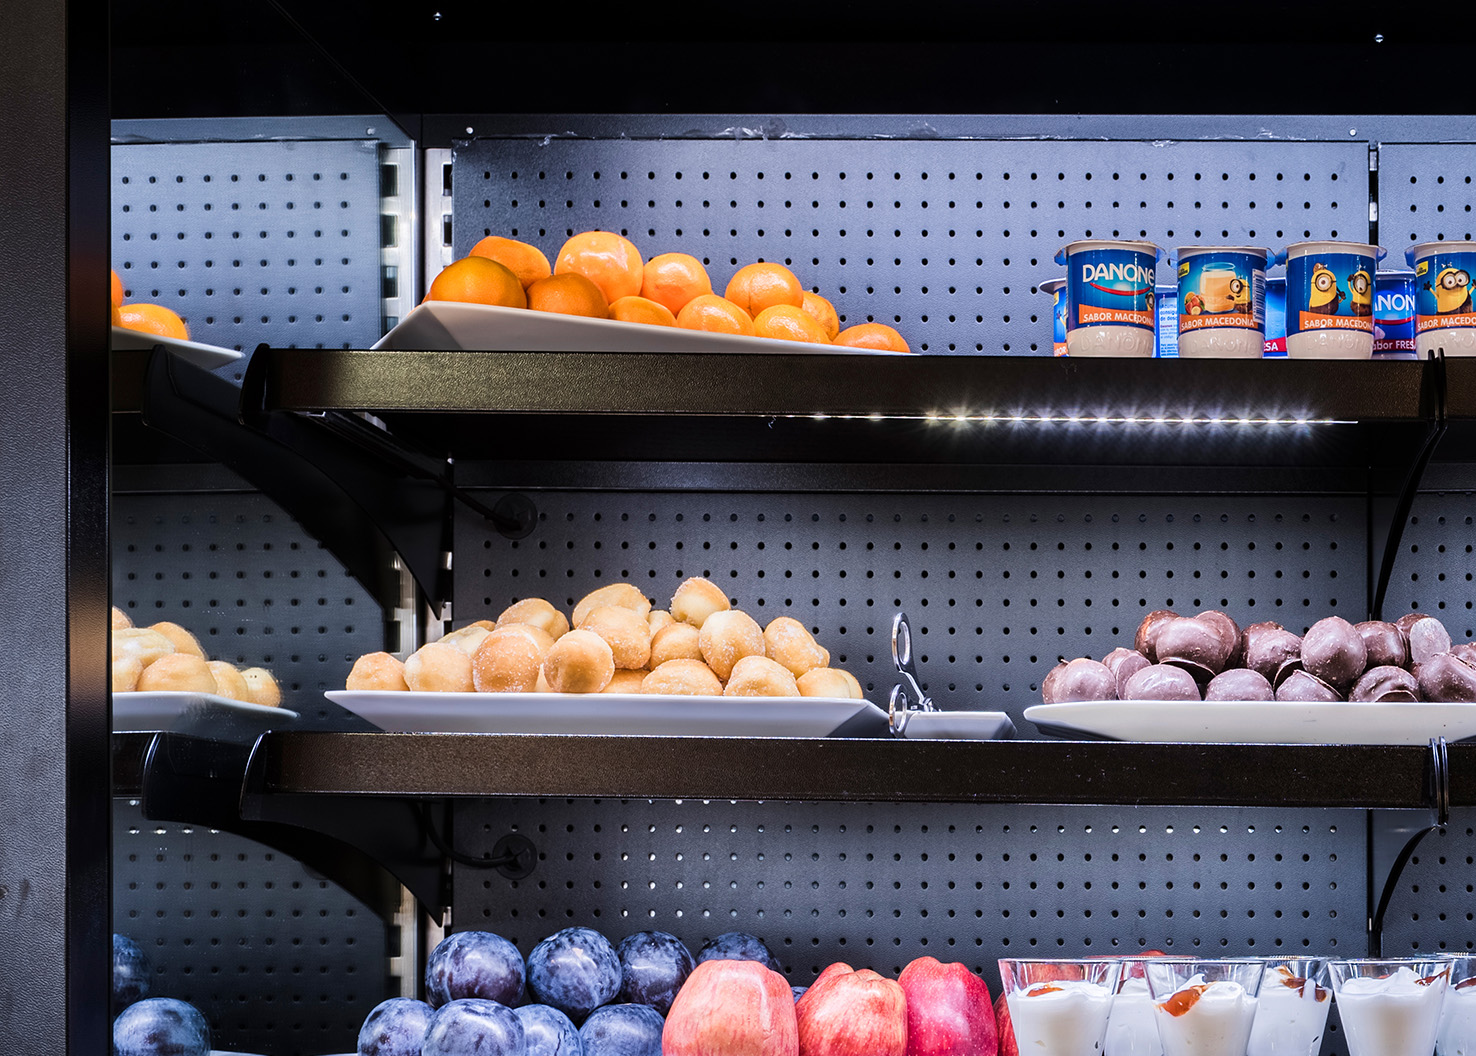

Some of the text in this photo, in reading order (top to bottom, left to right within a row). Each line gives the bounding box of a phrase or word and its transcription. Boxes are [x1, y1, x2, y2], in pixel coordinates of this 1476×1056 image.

[1083, 312, 1112, 322] SABOR
[1181, 317, 1254, 331] SABOR MACEDONIA
[1304, 318, 1333, 329] SABOR
[1417, 319, 1438, 331] SABOR
